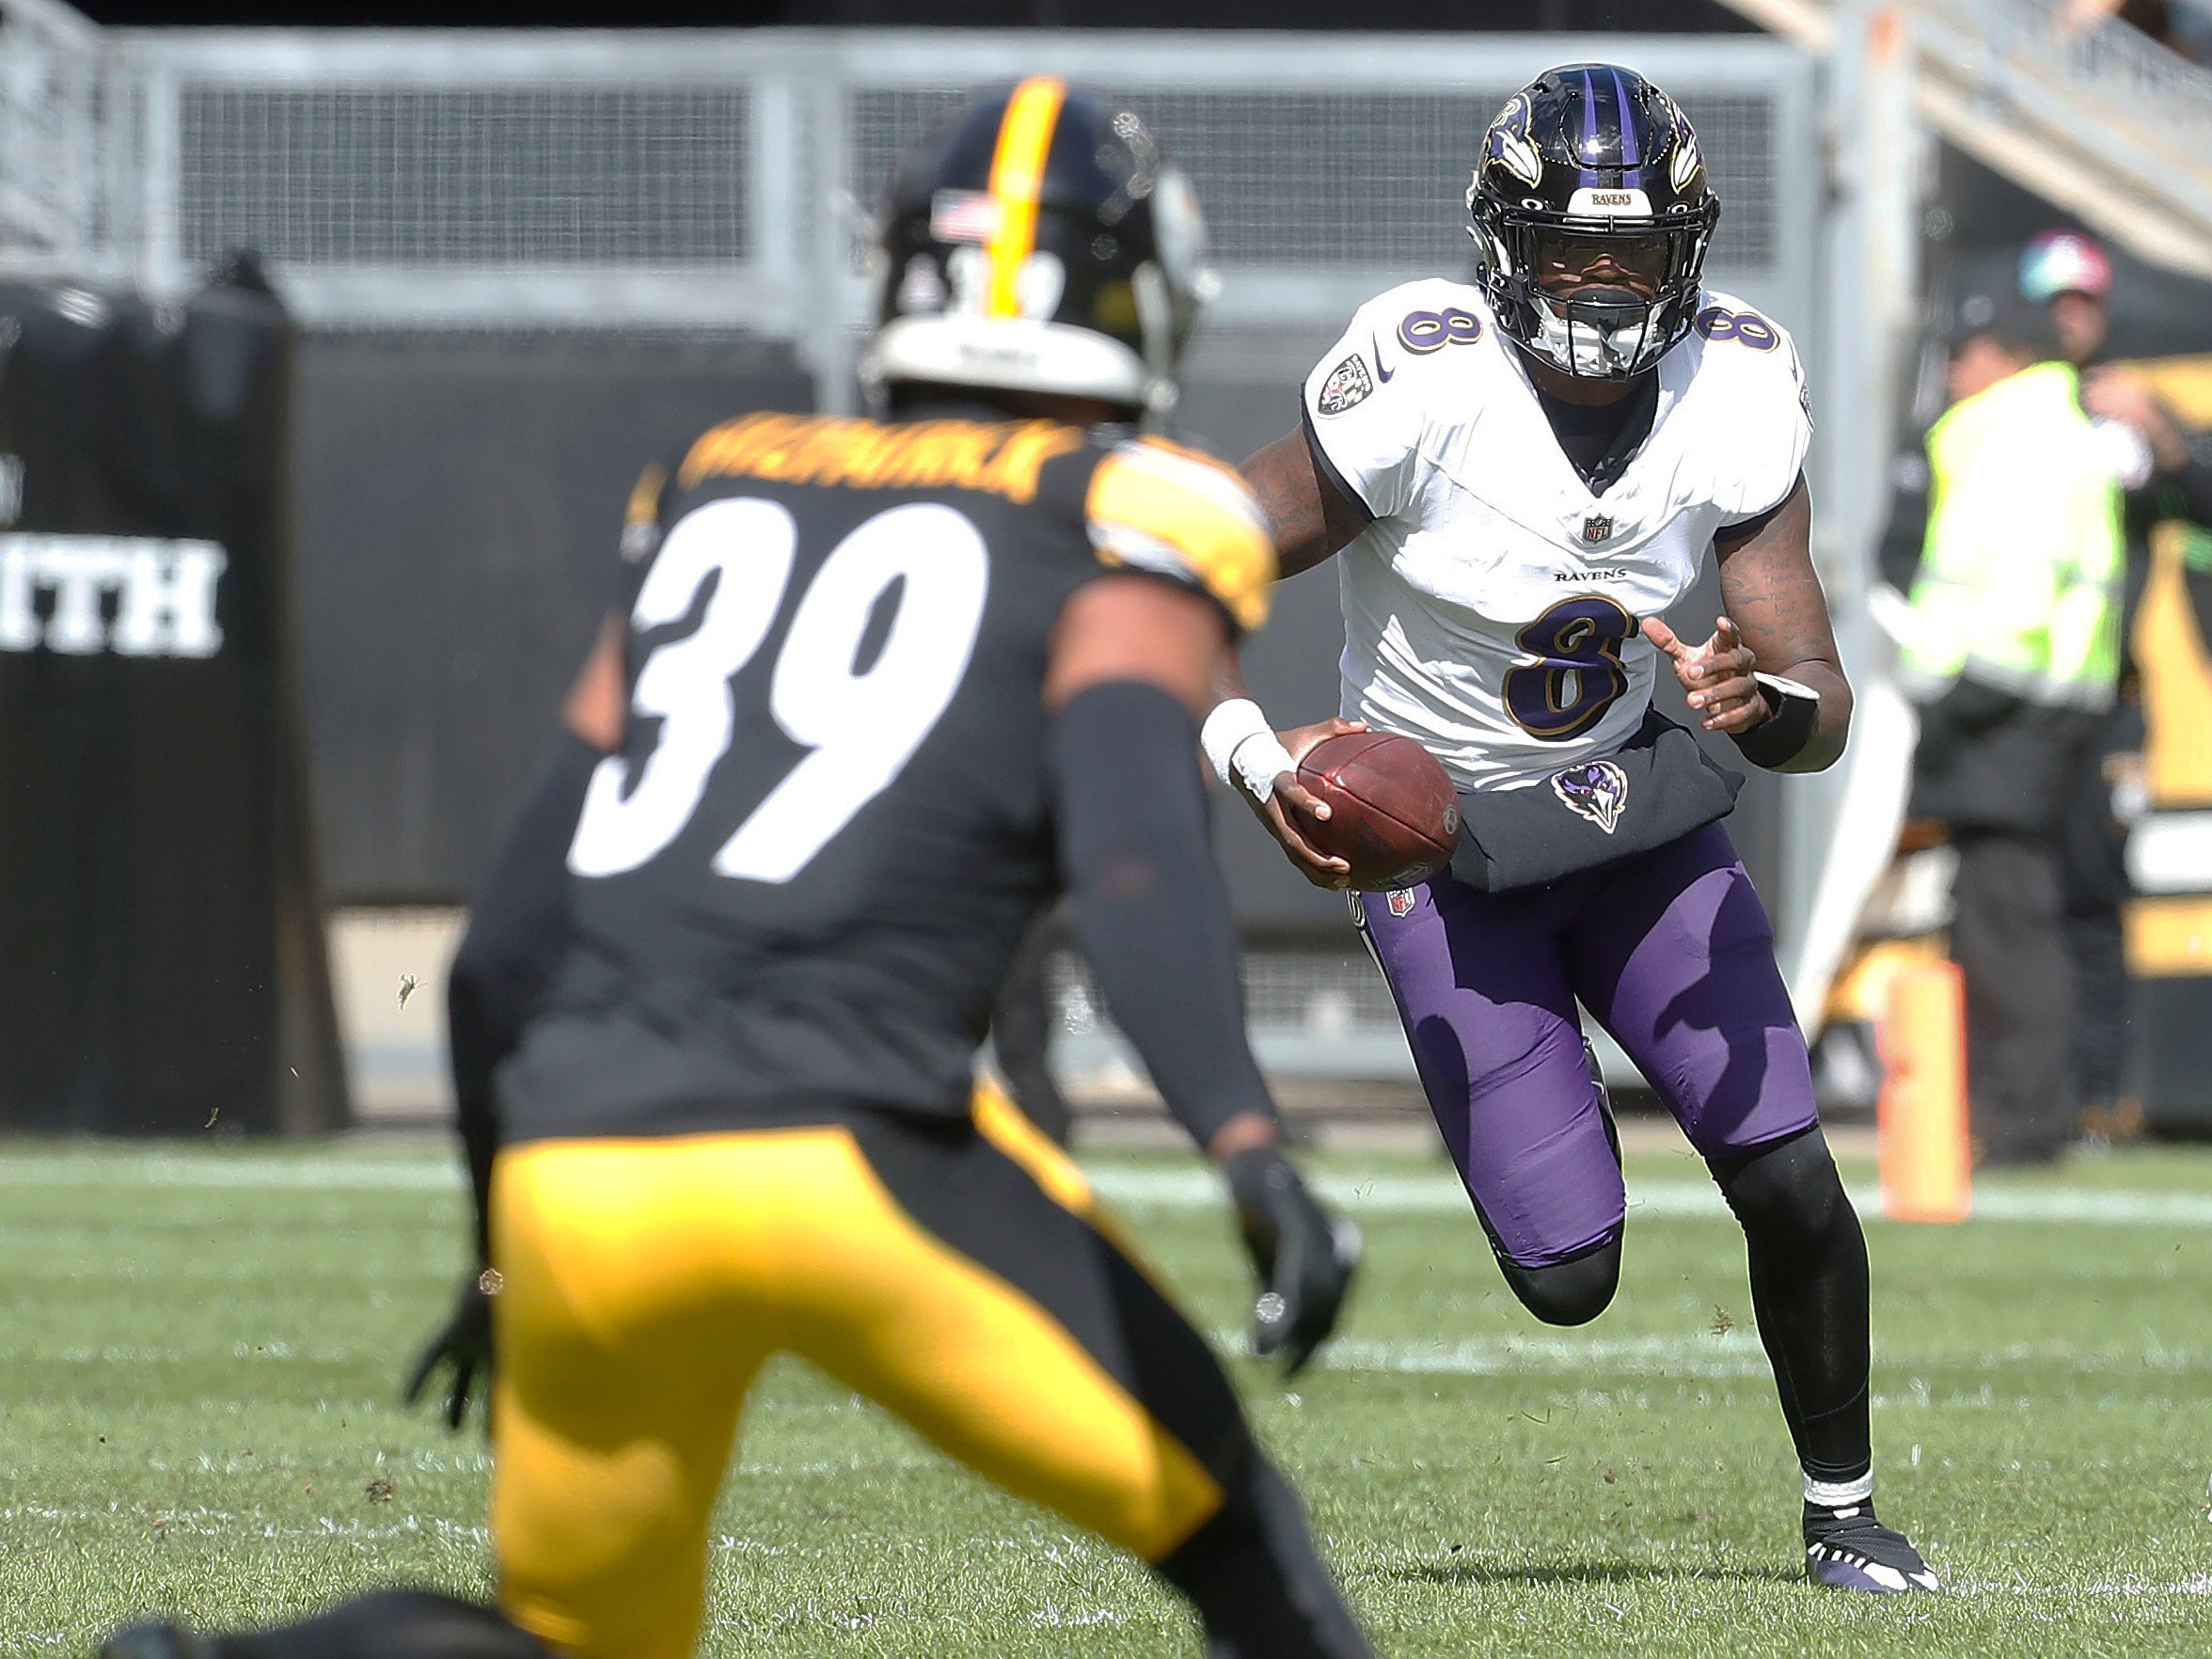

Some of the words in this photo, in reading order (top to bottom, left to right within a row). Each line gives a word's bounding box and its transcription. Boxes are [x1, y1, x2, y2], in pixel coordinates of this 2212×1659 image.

[1591, 194, 1632, 206] RAVENS
[1397, 307, 1484, 356] 8
[1693, 307, 1780, 354] 8
[1586, 527, 1609, 540] NFL
[0, 531, 229, 658] ITH
[1554, 568, 1627, 582] RAVENS
[566, 496, 989, 884] 39
[1501, 593, 1639, 741] 8
